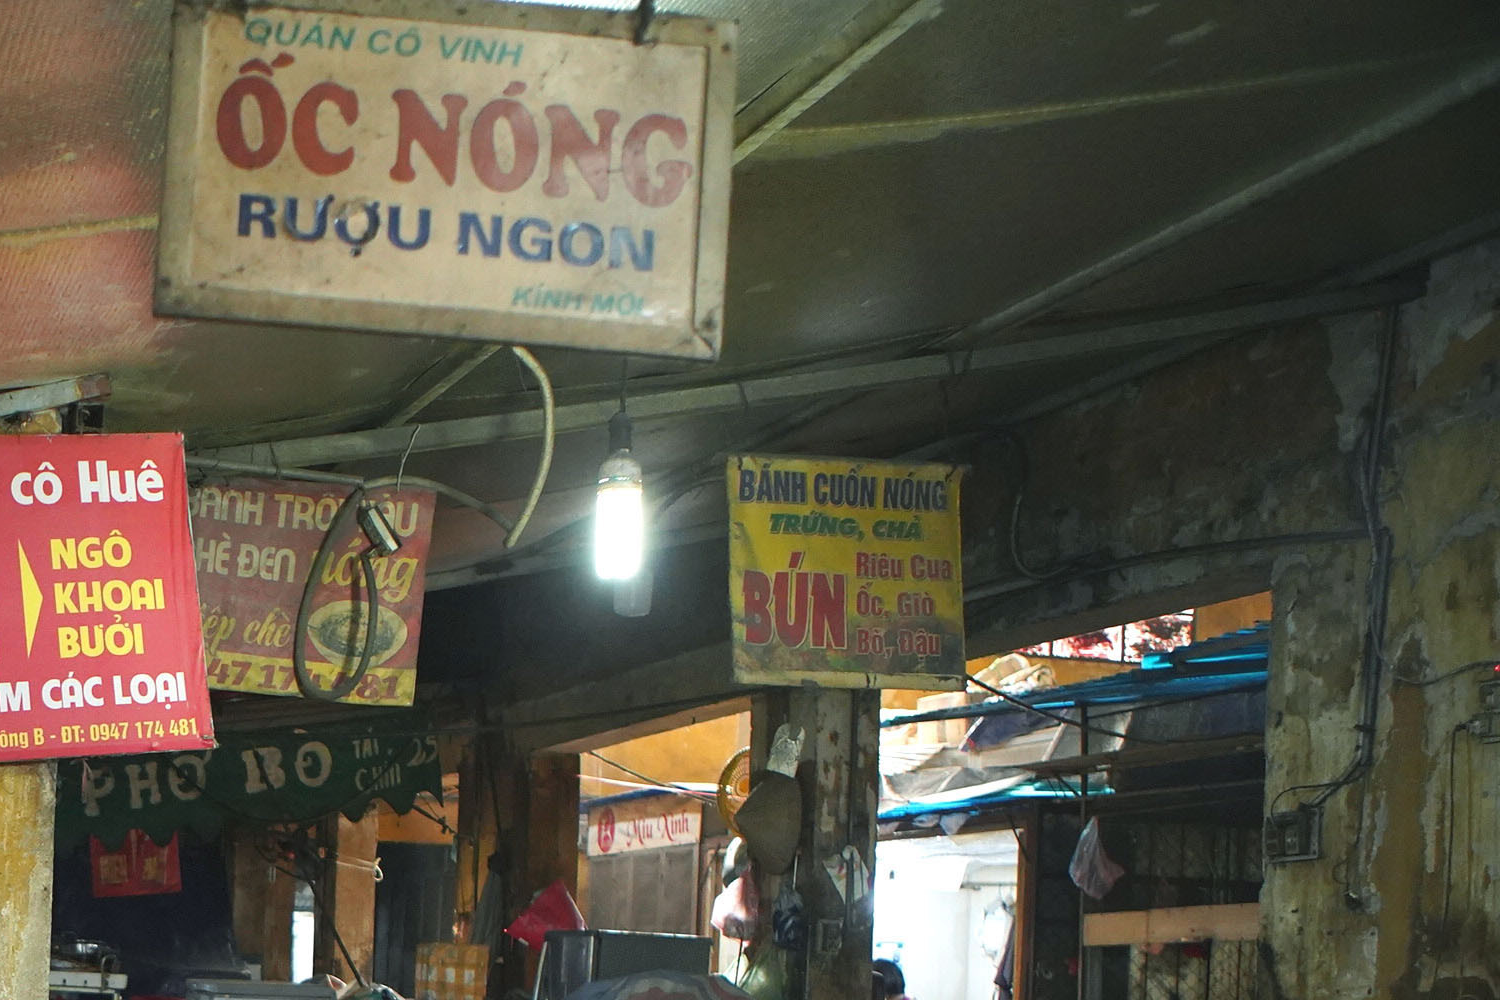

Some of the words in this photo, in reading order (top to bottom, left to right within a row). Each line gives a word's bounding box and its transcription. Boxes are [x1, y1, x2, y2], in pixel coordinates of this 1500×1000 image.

[244, 16, 356, 52] QUÁN
[367, 26, 422, 57] CÔ
[438, 34, 525, 68] VINH
[216, 52, 359, 177] ỐC
[389, 80, 693, 208] NÓNG
[237, 192, 432, 258] RƯỢU
[457, 211, 654, 271] NGON
[10, 461, 63, 505] cô
[77, 459, 165, 503] Huê
[739, 463, 807, 504] BÁNH
[813, 465, 877, 509] CUỐN
[884, 472, 948, 512] NÓNG
[770, 509, 865, 541] TRỨNG,
[872, 514, 924, 542] CHẢ
[50, 529, 132, 569] NGÔ
[237, 543, 296, 583] ĐEN
[856, 552, 905, 580] Riêu
[910, 554, 953, 581] Cua
[53, 579, 165, 614] KHOAI
[743, 551, 847, 650] BÚN
[897, 592, 936, 617] Giò
[58, 614, 144, 659] BƯỞI
[243, 607, 292, 648] chè
[898, 628, 941, 661] Đậu
[41, 671, 105, 709] CÁC
[113, 671, 187, 710] LOẠI
[34, 728, 44, 745] B
[61, 725, 85, 744] ĐT:
[90, 721, 129, 741] 0947
[135, 720, 164, 738] 174
[169, 717, 197, 736] 481
